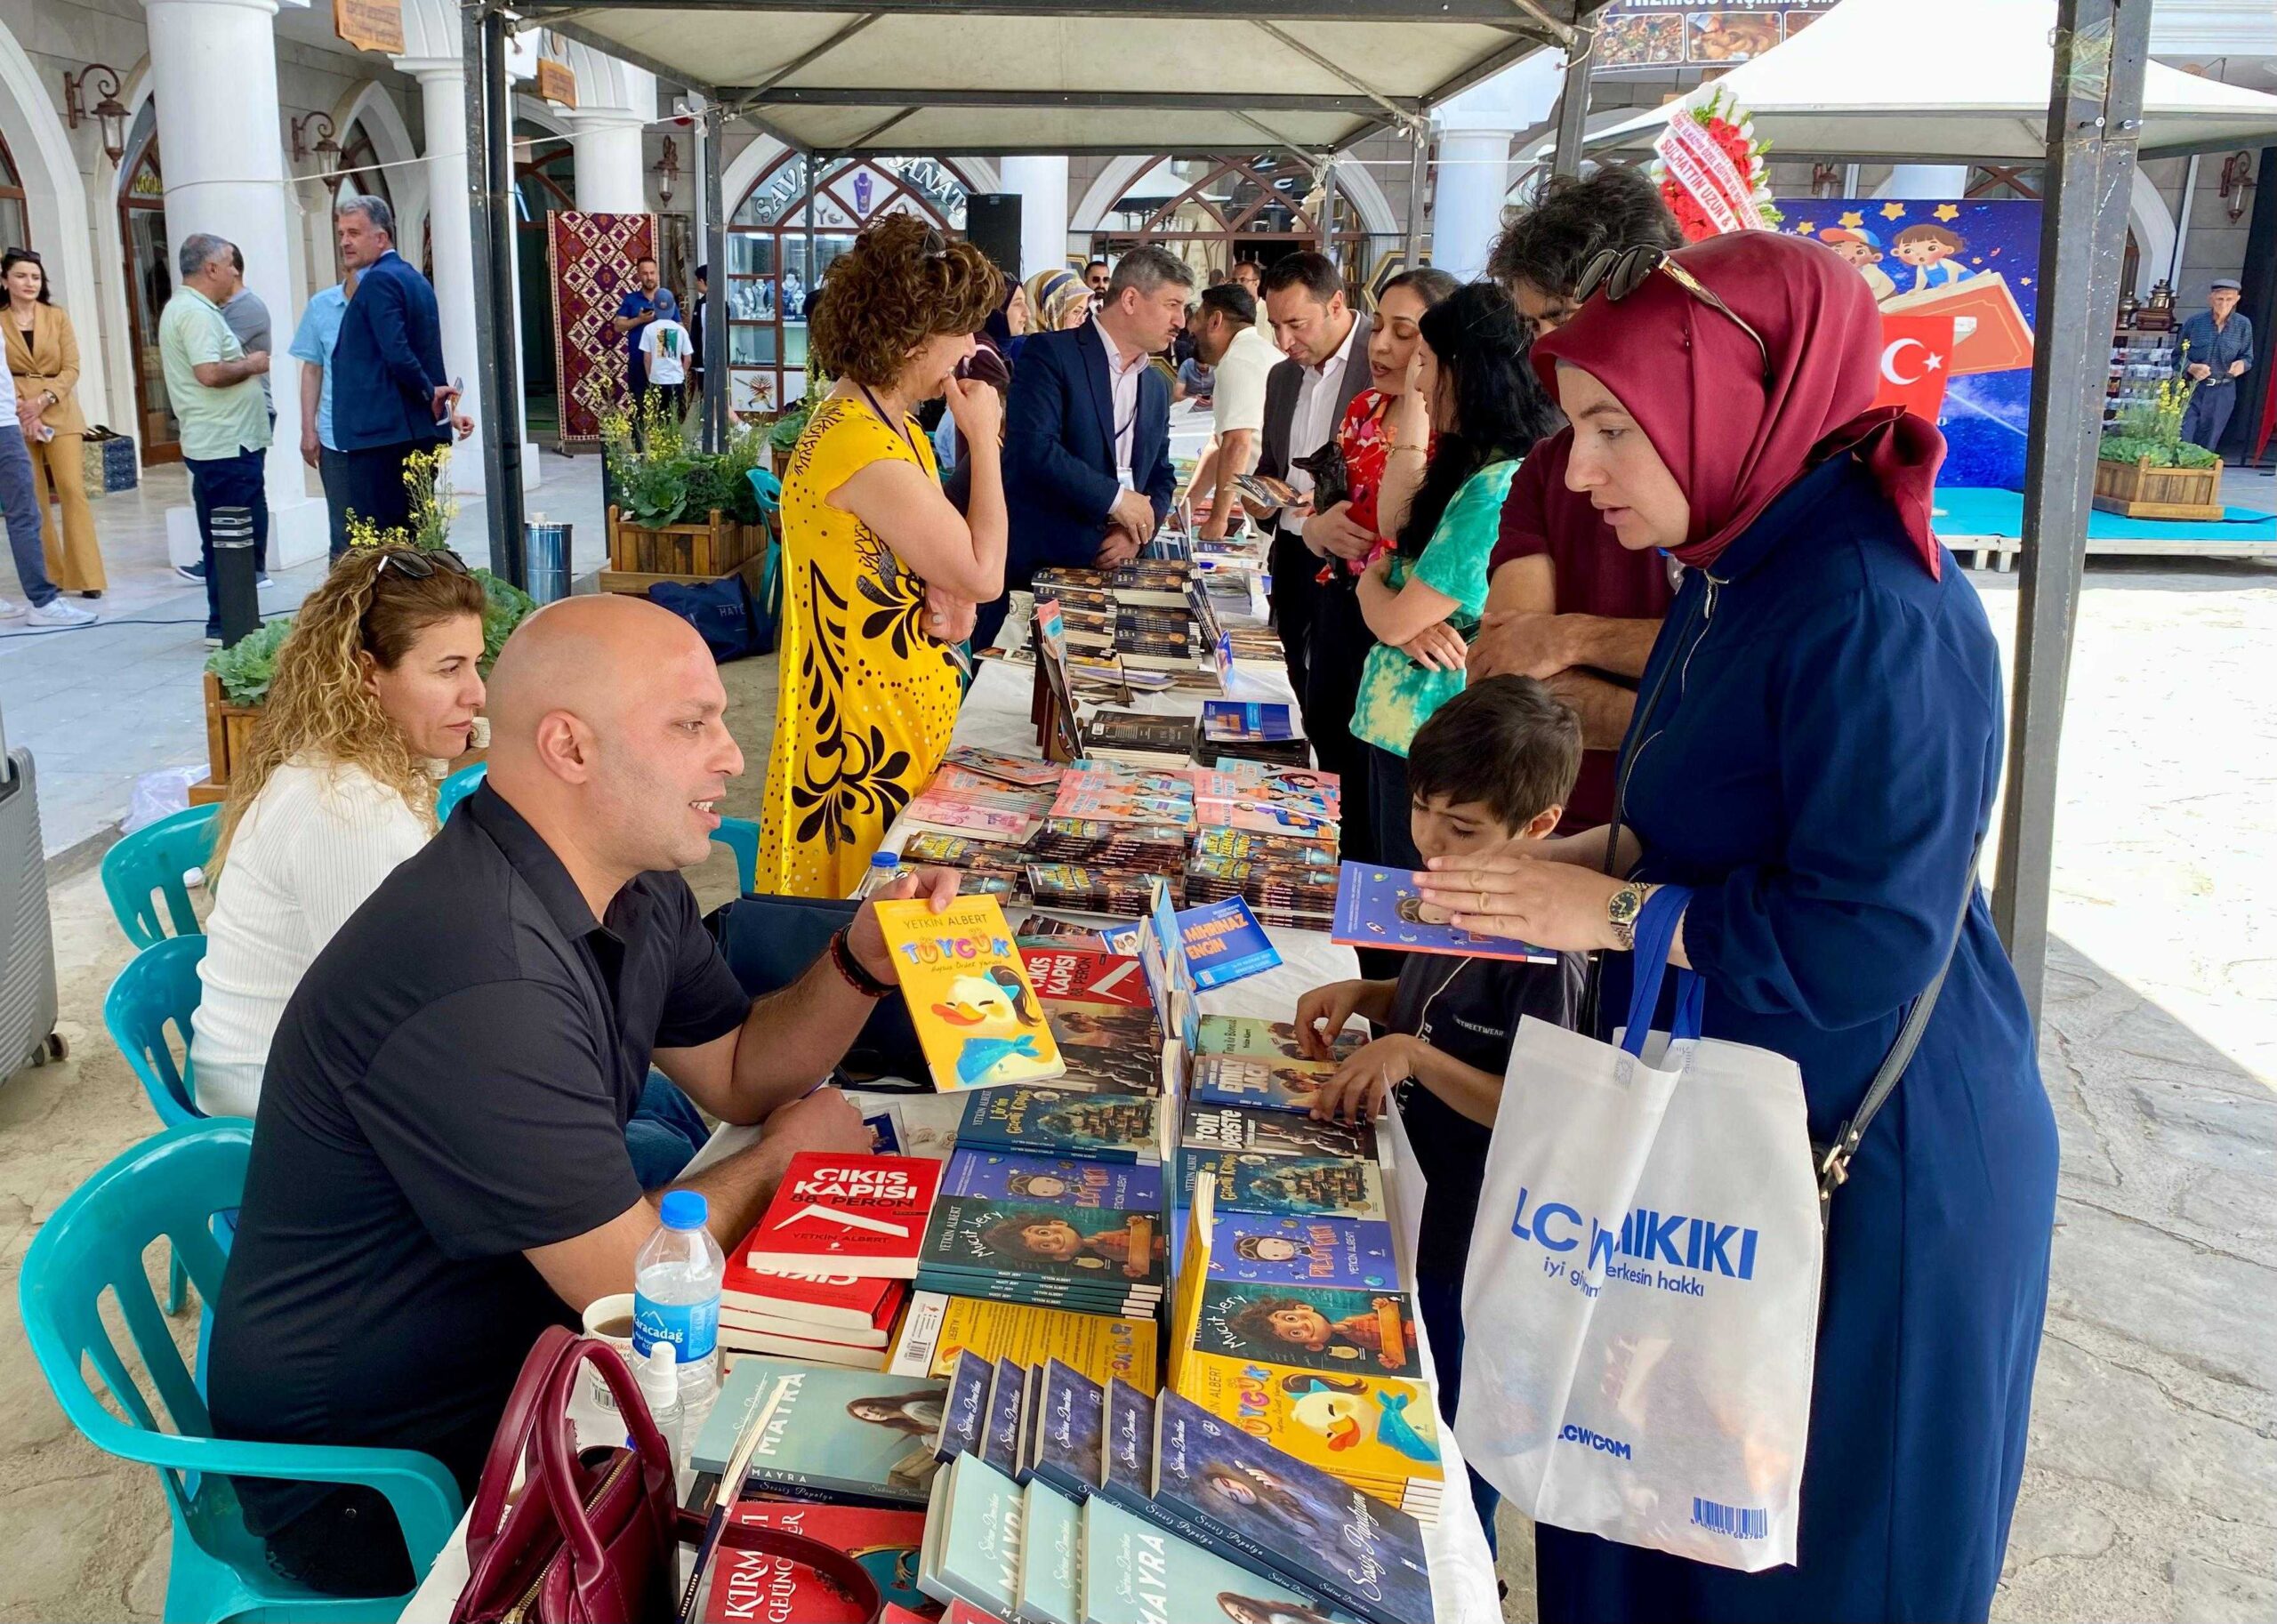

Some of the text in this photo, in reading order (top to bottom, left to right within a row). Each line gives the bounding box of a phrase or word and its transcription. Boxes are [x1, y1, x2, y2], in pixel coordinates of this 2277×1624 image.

[1701, 181, 1726, 218] UZUN
[904, 914, 987, 929] YETKİN ALBERT
[900, 929, 1010, 965] TÜYCÜK
[1046, 954, 1077, 995] KAPISI
[793, 1181, 918, 1199] KAPISI
[813, 1169, 908, 1185] ÇIKIŞ
[832, 1196, 914, 1207] PERON
[1114, 1192, 1126, 1210] ETKİN
[938, 1206, 961, 1252] YETKİN ALBERT
[970, 1210, 1004, 1231] Jery
[1511, 1187, 1583, 1252] LC
[793, 1233, 889, 1243] YETKİN ALBERT
[960, 1230, 994, 1258] Mucit
[1544, 1257, 1704, 1298] iyi erkesin hakkı
[1206, 1293, 1248, 1350] Mucit Jery
[1211, 1366, 1221, 1399] ALBERT
[1234, 1363, 1274, 1443] ÜYCÜK
[752, 1468, 808, 1483] MAYRA
[795, 1486, 833, 1500] Papatya
[1227, 1532, 1263, 1556] Papatya
[1347, 1556, 1386, 1602] Sessiz
